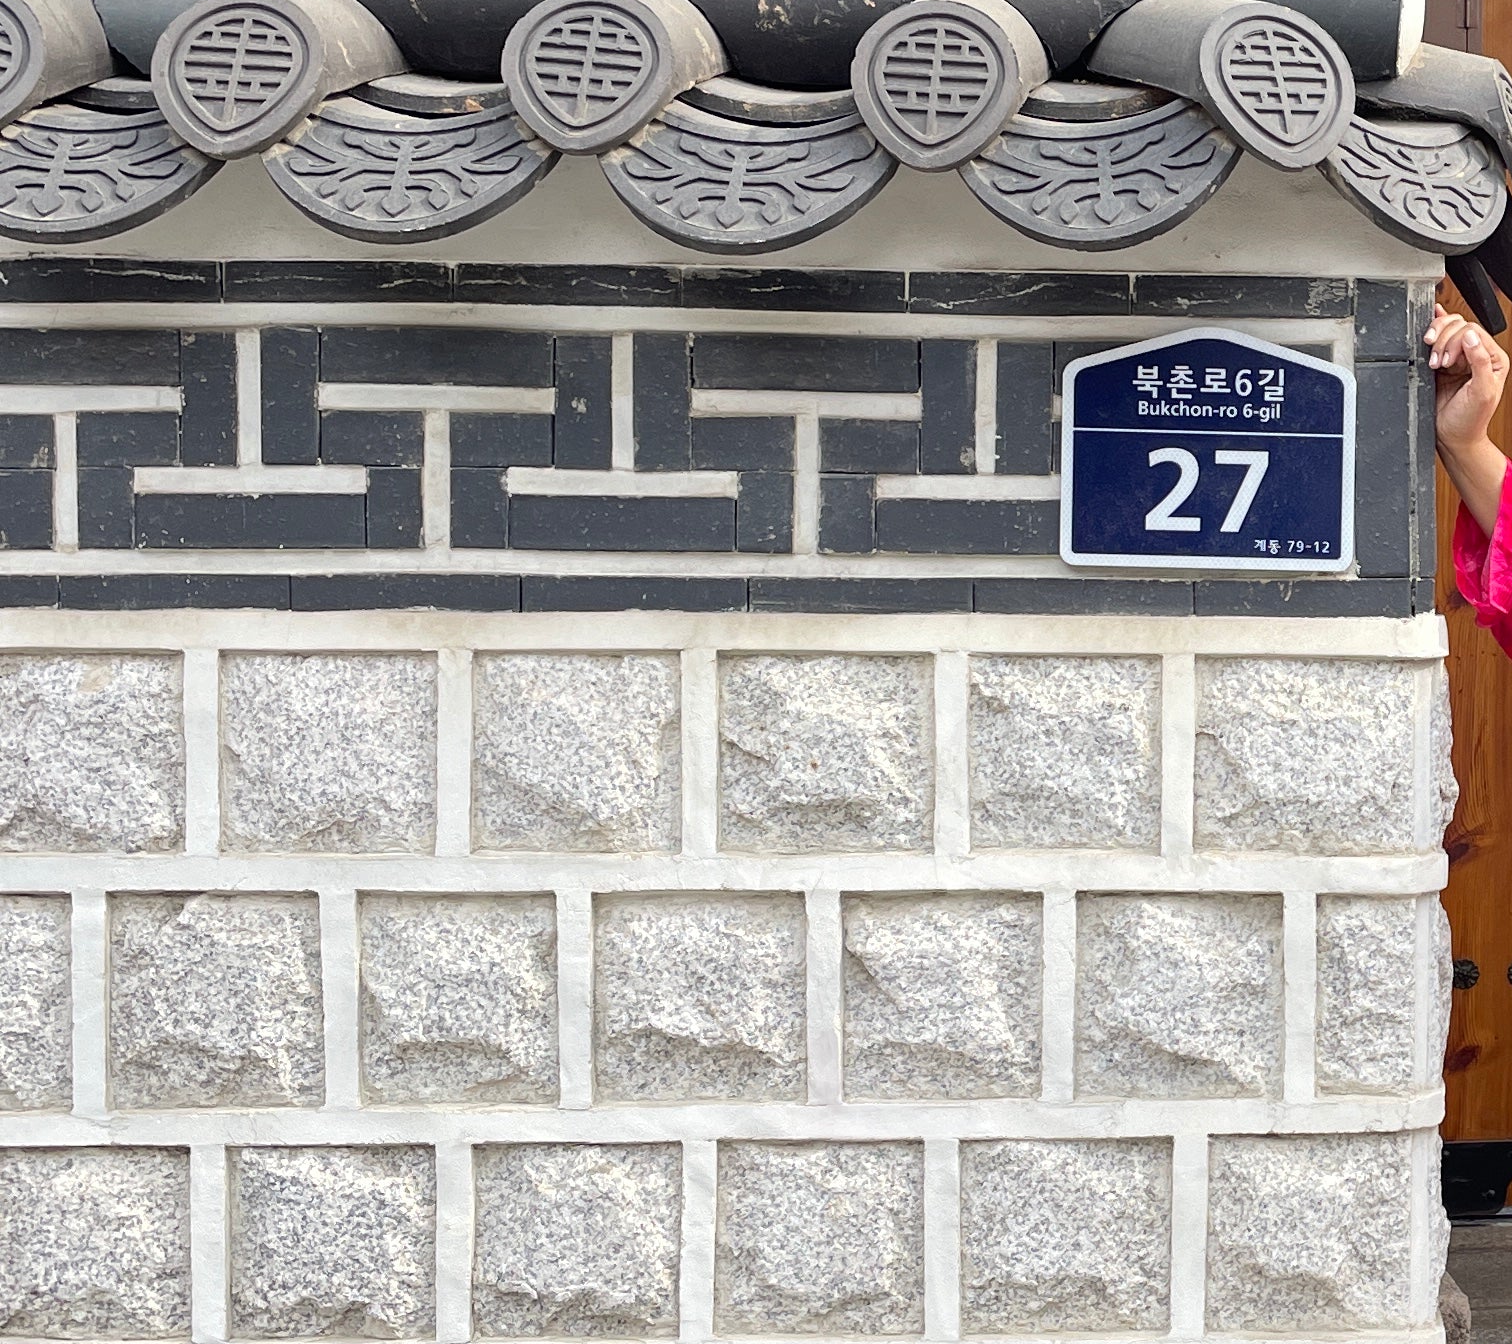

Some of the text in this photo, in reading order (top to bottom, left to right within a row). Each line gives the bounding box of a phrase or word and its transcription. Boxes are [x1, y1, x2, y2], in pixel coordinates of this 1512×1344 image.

[1132, 364, 1286, 402] 북촌로6길
[1138, 400, 1281, 422] Bukchon-ro 6-gil
[1144, 447, 1270, 533] 27
[1253, 539, 1330, 554] 계동 79-12
